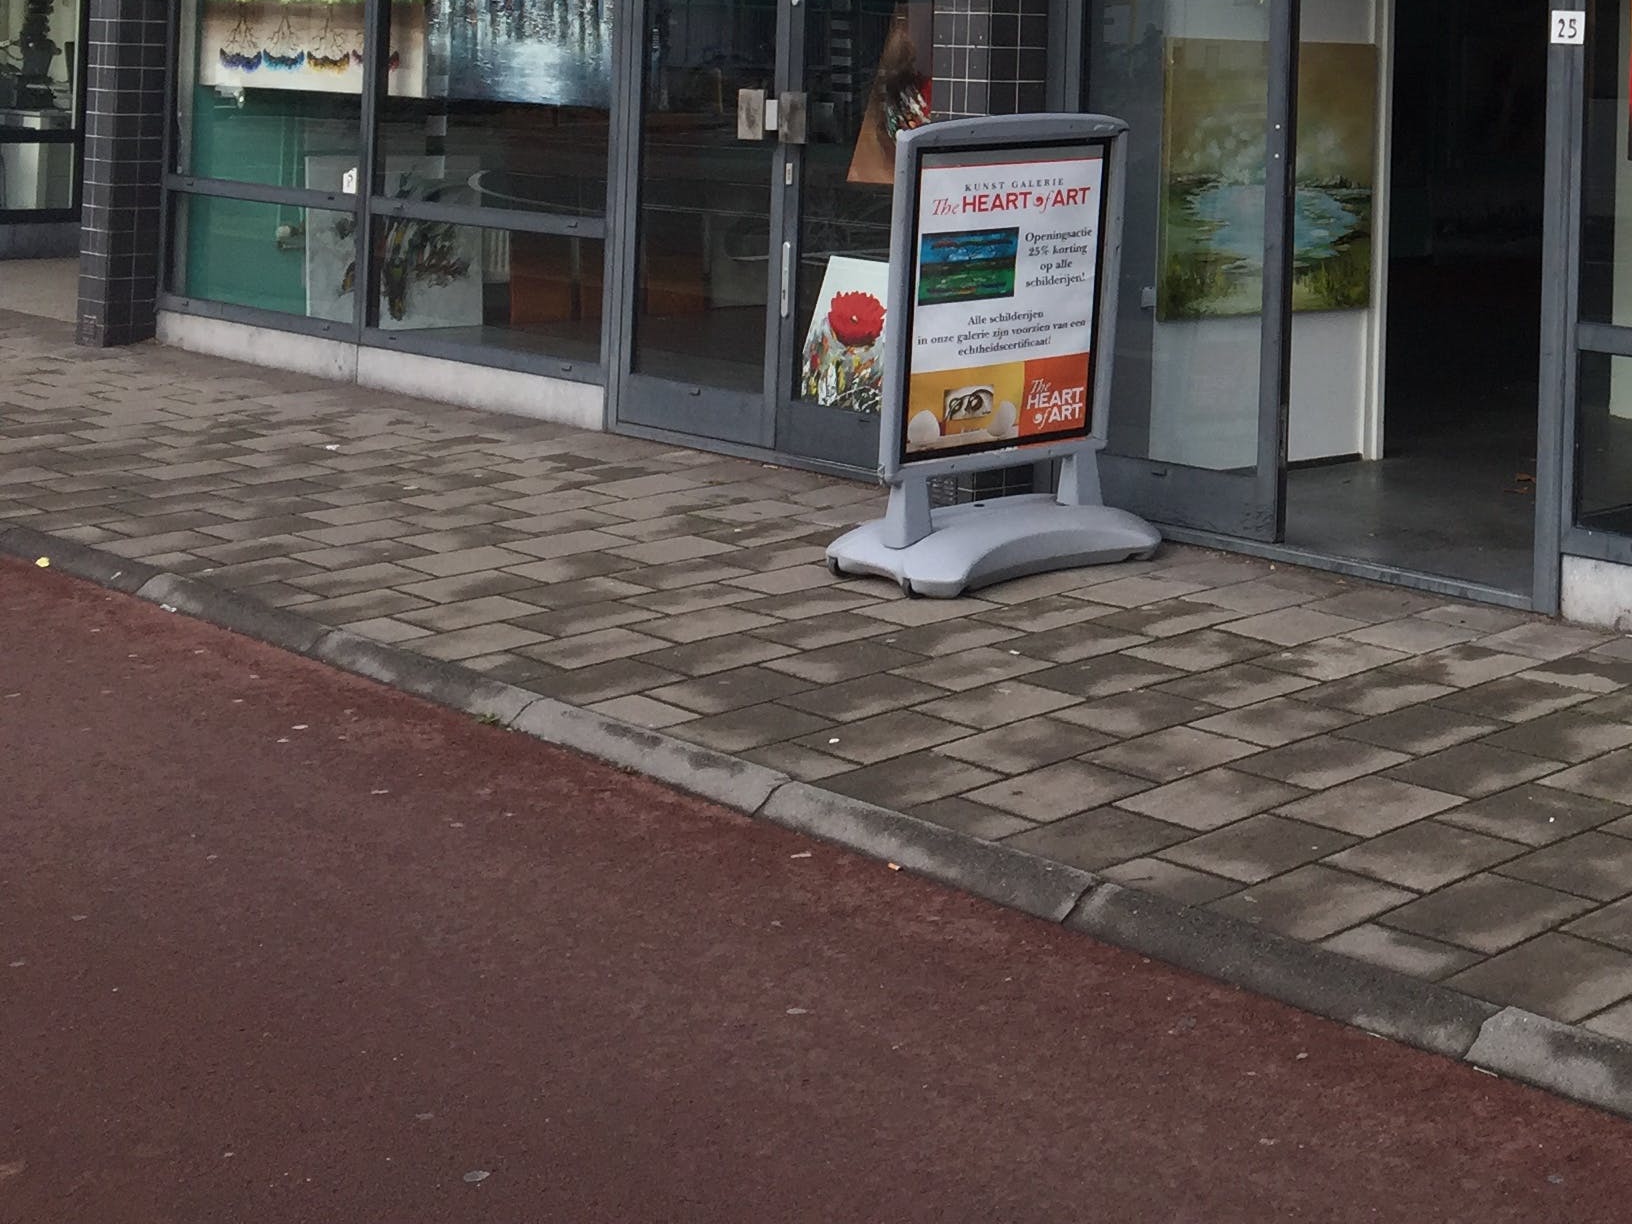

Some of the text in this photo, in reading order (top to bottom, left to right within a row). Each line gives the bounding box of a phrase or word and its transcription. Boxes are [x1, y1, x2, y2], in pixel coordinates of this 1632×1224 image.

[1558, 18, 1577, 39] 25
[965, 177, 1064, 192] KUNST GALERIE
[931, 197, 958, 216] The
[962, 191, 1032, 214] HEART
[1052, 187, 1091, 208] ART
[1025, 227, 1093, 244] Openingsactie
[1028, 243, 1088, 257] 25% korting
[1040, 259, 1073, 273] op alle
[1025, 274, 1086, 289] schilderijen!
[968, 309, 1044, 326] Alle schilderijen
[917, 319, 1086, 345] in onze galerie zijn voorzien van een
[958, 335, 1051, 356] echtheidscertificaat!
[1031, 378, 1051, 394] The
[1026, 387, 1084, 410] HEART
[1048, 403, 1084, 423] ART
